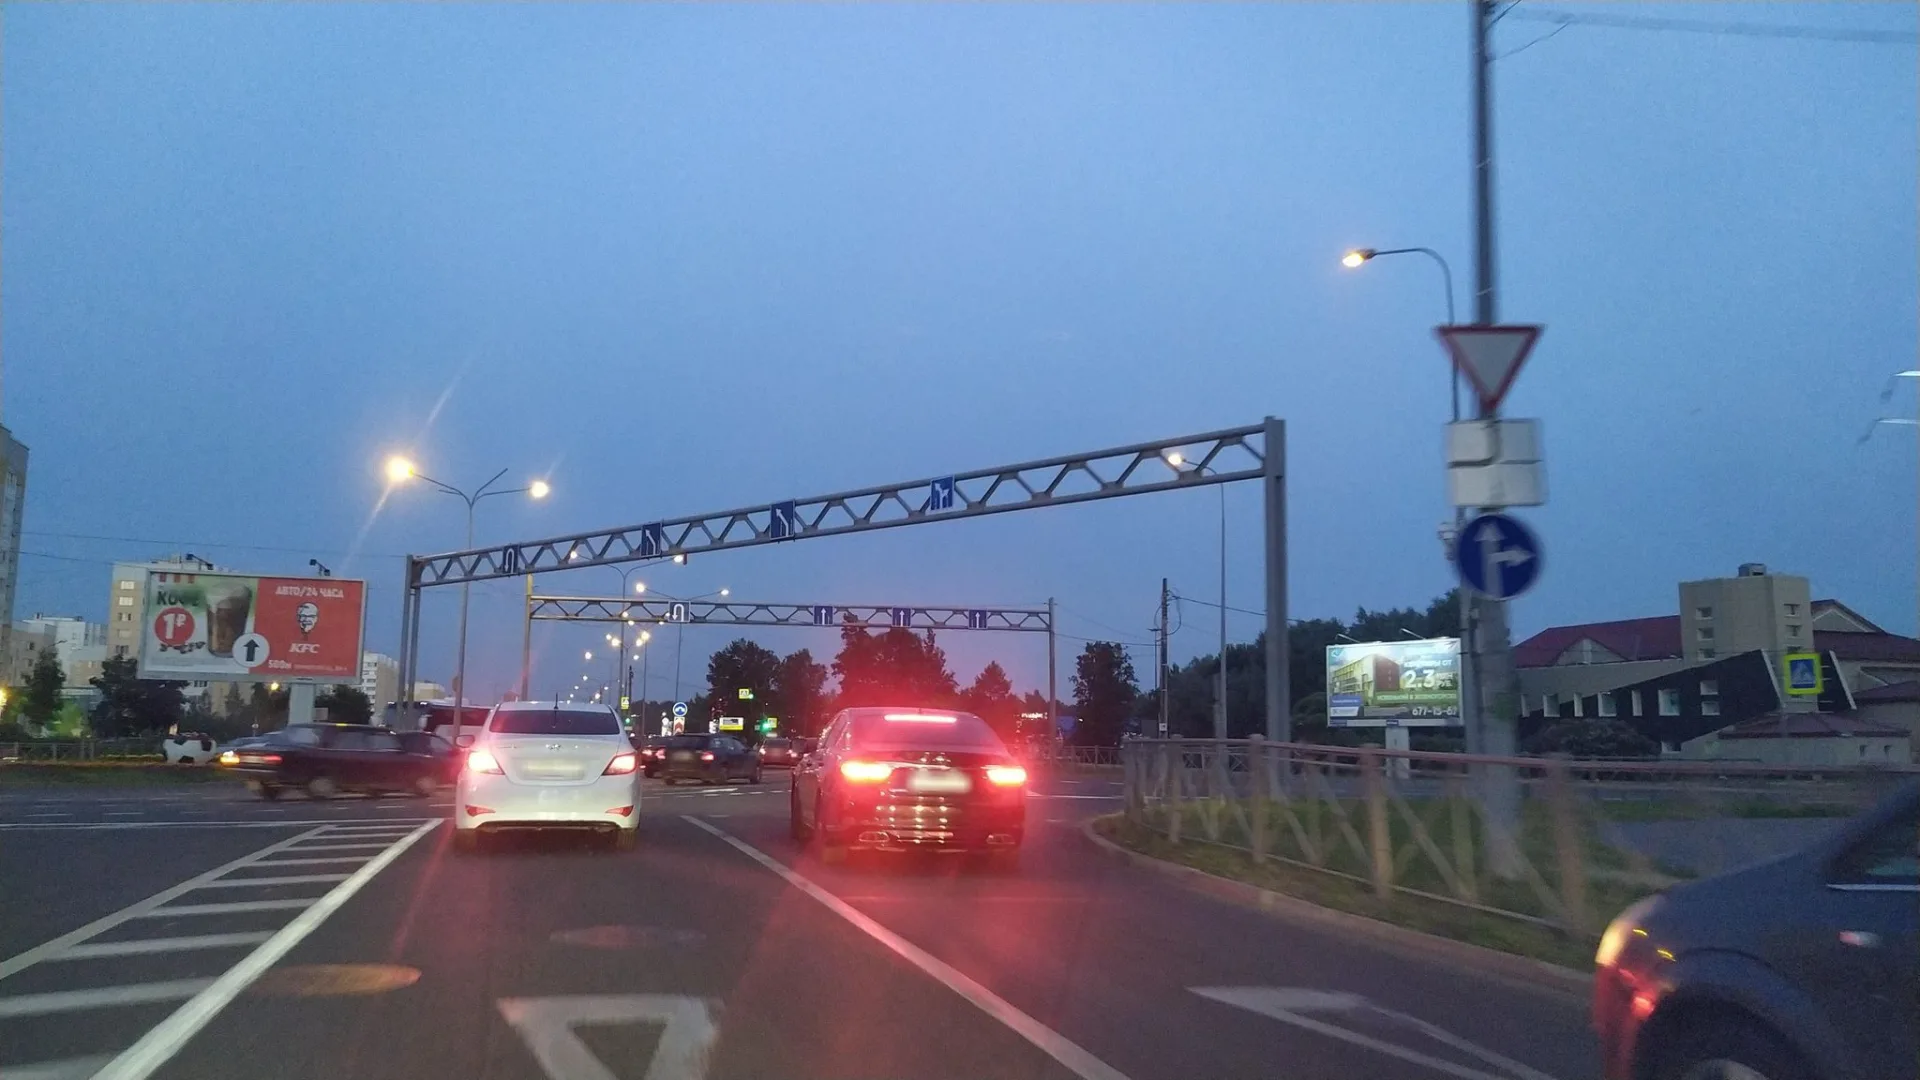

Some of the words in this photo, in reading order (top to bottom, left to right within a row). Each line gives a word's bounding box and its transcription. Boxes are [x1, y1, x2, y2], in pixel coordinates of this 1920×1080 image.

[319, 587, 344, 598] ЧАСА
[289, 643, 321, 653] KFC
[1404, 668, 1435, 688] 2.3
